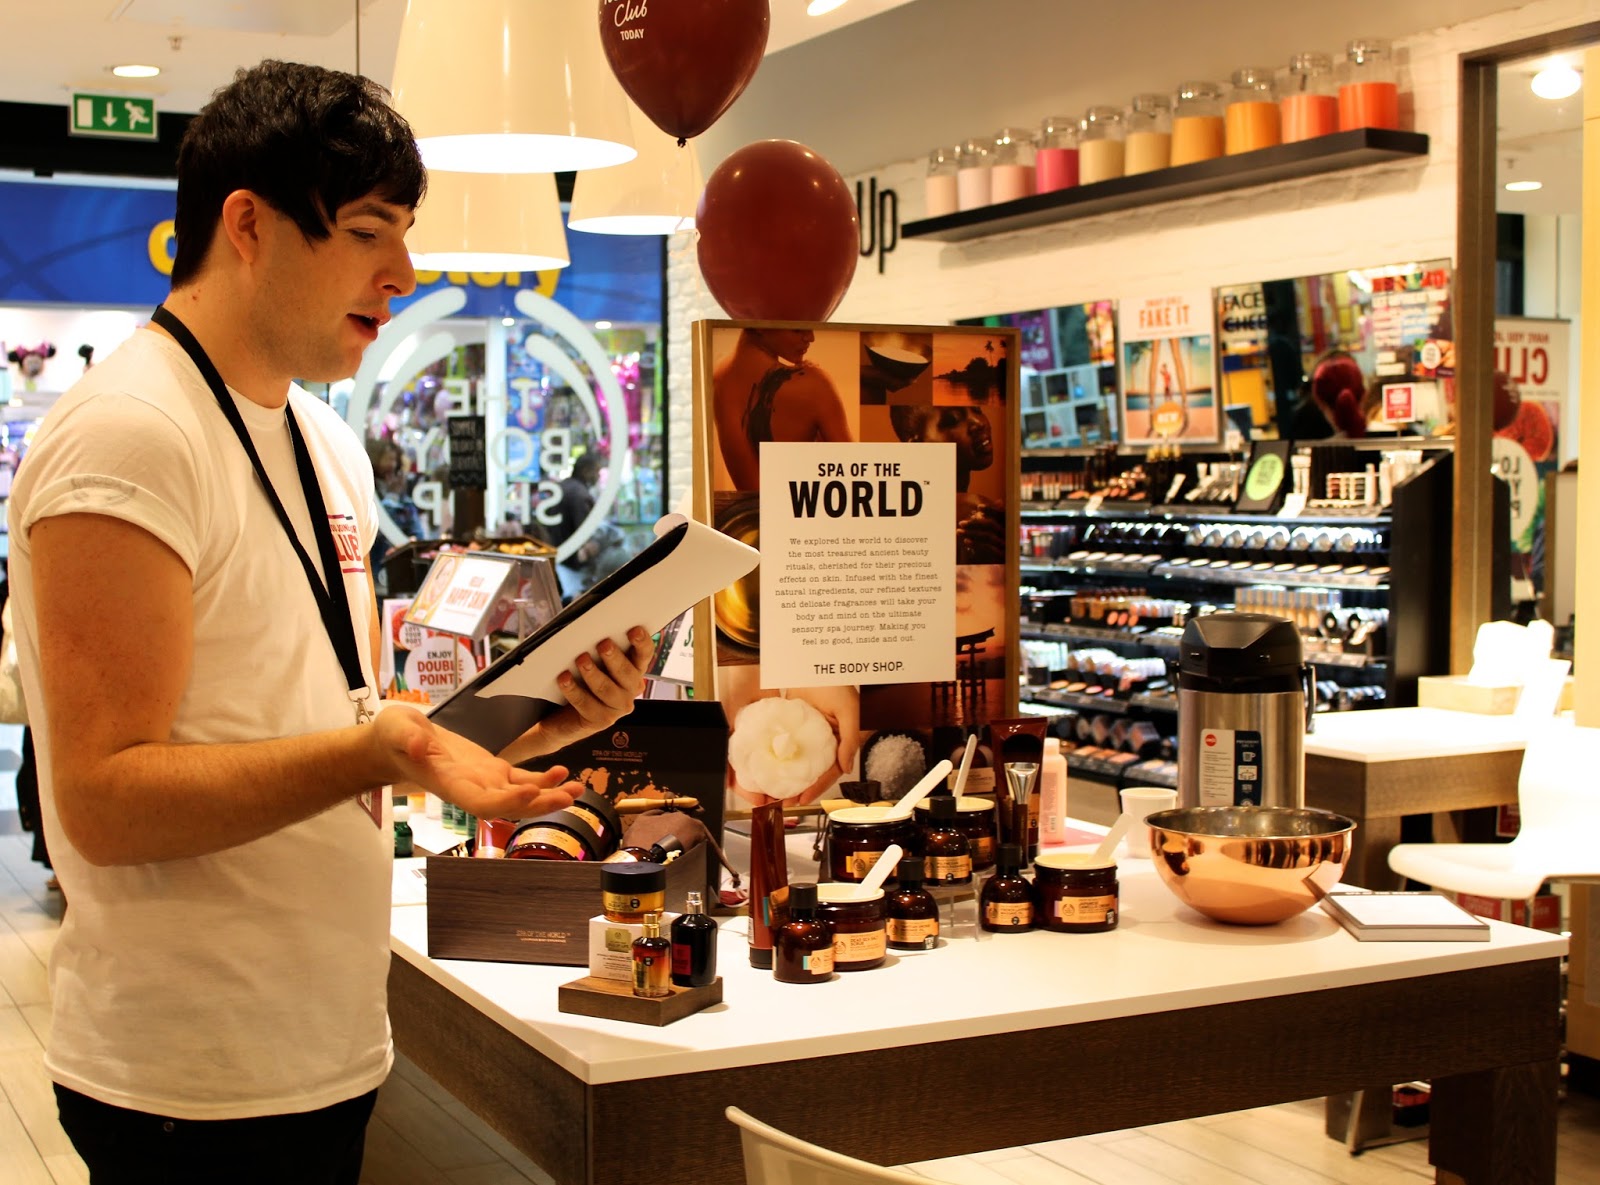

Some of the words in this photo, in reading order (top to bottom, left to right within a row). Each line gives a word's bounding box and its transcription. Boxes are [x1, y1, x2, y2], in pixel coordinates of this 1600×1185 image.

[614, 0, 648, 27] Club
[619, 28, 645, 41] TODAY
[856, 177, 898, 274] Up
[1139, 307, 1171, 329] FAKE
[1176, 304, 1190, 325] IT
[818, 463, 845, 477] SPA
[850, 463, 869, 476] OF
[874, 463, 901, 476] THE
[789, 538, 801, 546] We
[804, 538, 839, 546] explored
[858, 537, 881, 545] world
[331, 533, 362, 562] LUB
[827, 550, 867, 558] treasured
[902, 549, 929, 557] beauty
[818, 562, 857, 570] cherished
[898, 562, 931, 570] precious
[779, 576, 806, 584] effects
[915, 573, 938, 581] finest
[775, 589, 806, 597] natural
[877, 586, 905, 594] refined
[781, 601, 796, 609] and
[834, 600, 877, 608] fragrances
[897, 598, 915, 606] take
[917, 599, 936, 607] your
[796, 614, 815, 622] body
[818, 613, 833, 621] and
[837, 612, 857, 620] mind
[872, 611, 885, 619] the
[827, 626, 841, 634] spa
[879, 623, 909, 631] Making
[802, 638, 817, 646] feel
[856, 636, 880, 644] inside
[427, 650, 452, 659] ENJOY
[814, 664, 836, 674] THE
[839, 663, 870, 673] BODY
